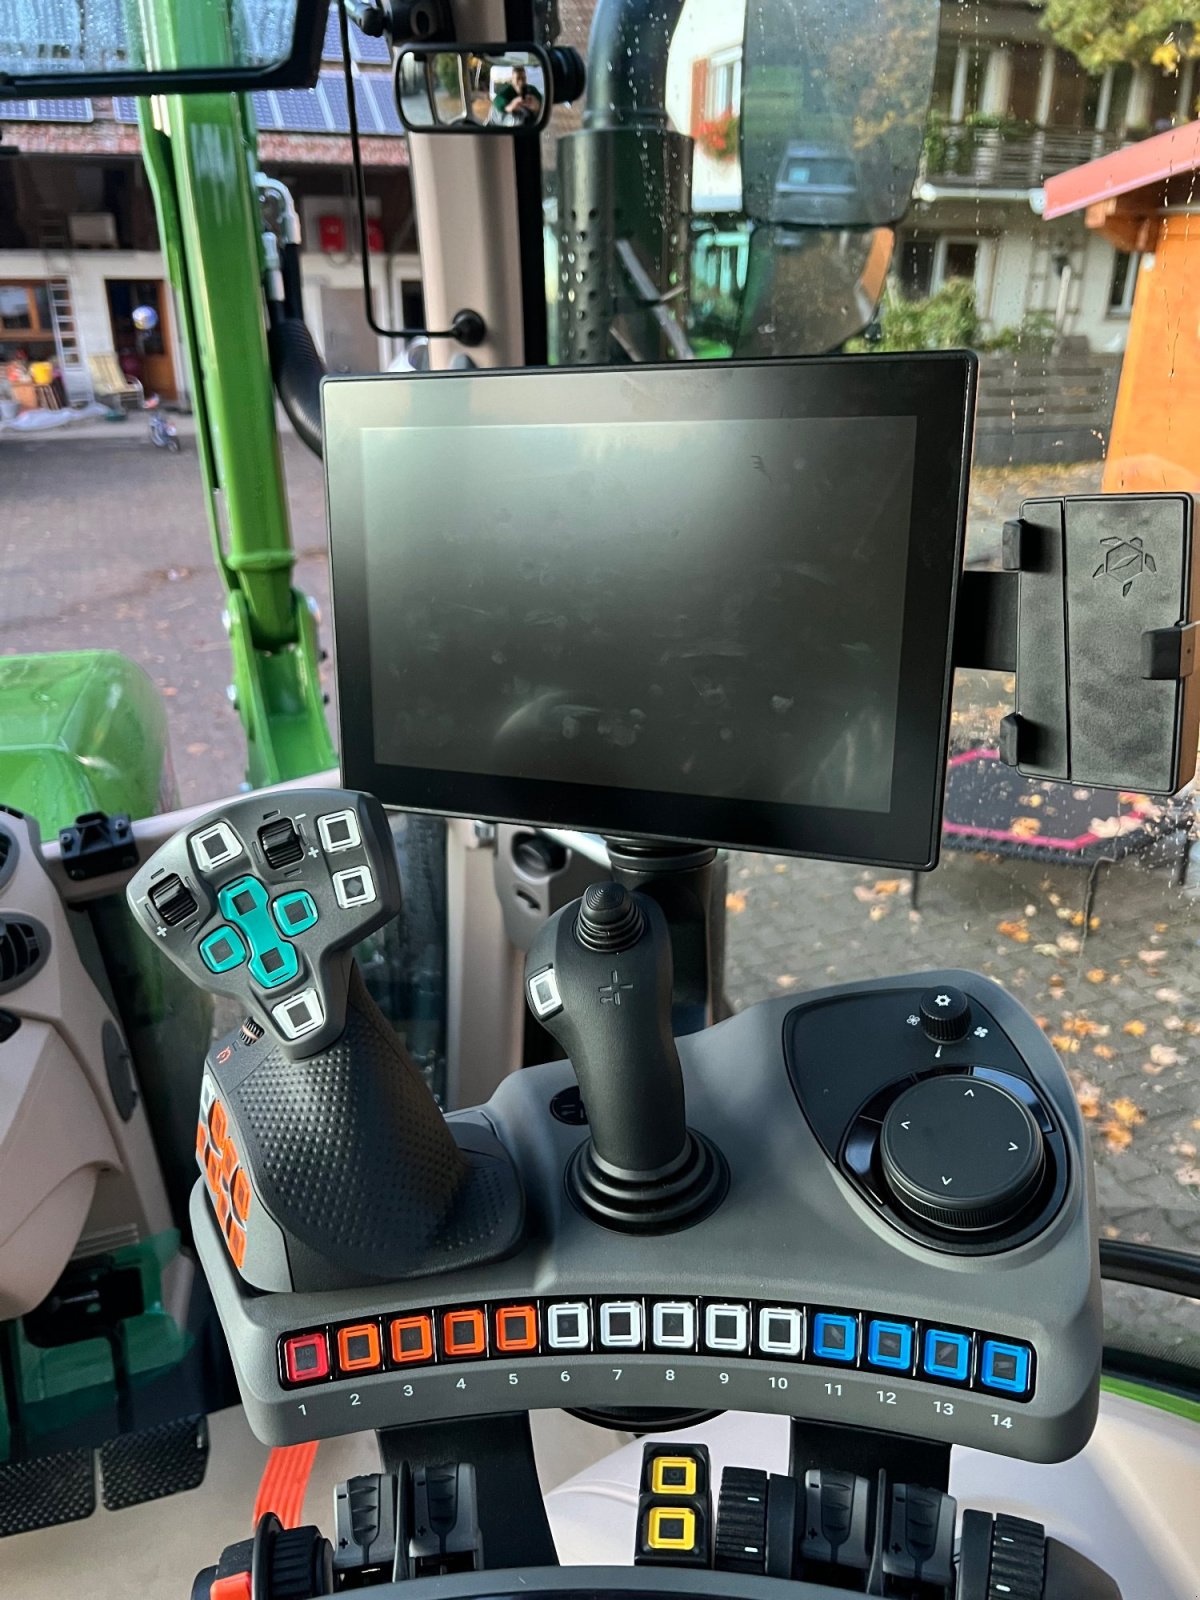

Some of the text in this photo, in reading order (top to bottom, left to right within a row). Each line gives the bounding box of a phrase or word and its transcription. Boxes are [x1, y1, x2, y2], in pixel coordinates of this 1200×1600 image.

[298, 1369, 1013, 1429] 1 2 3 4 5 6 7 8 9 10 11 12 13 14
